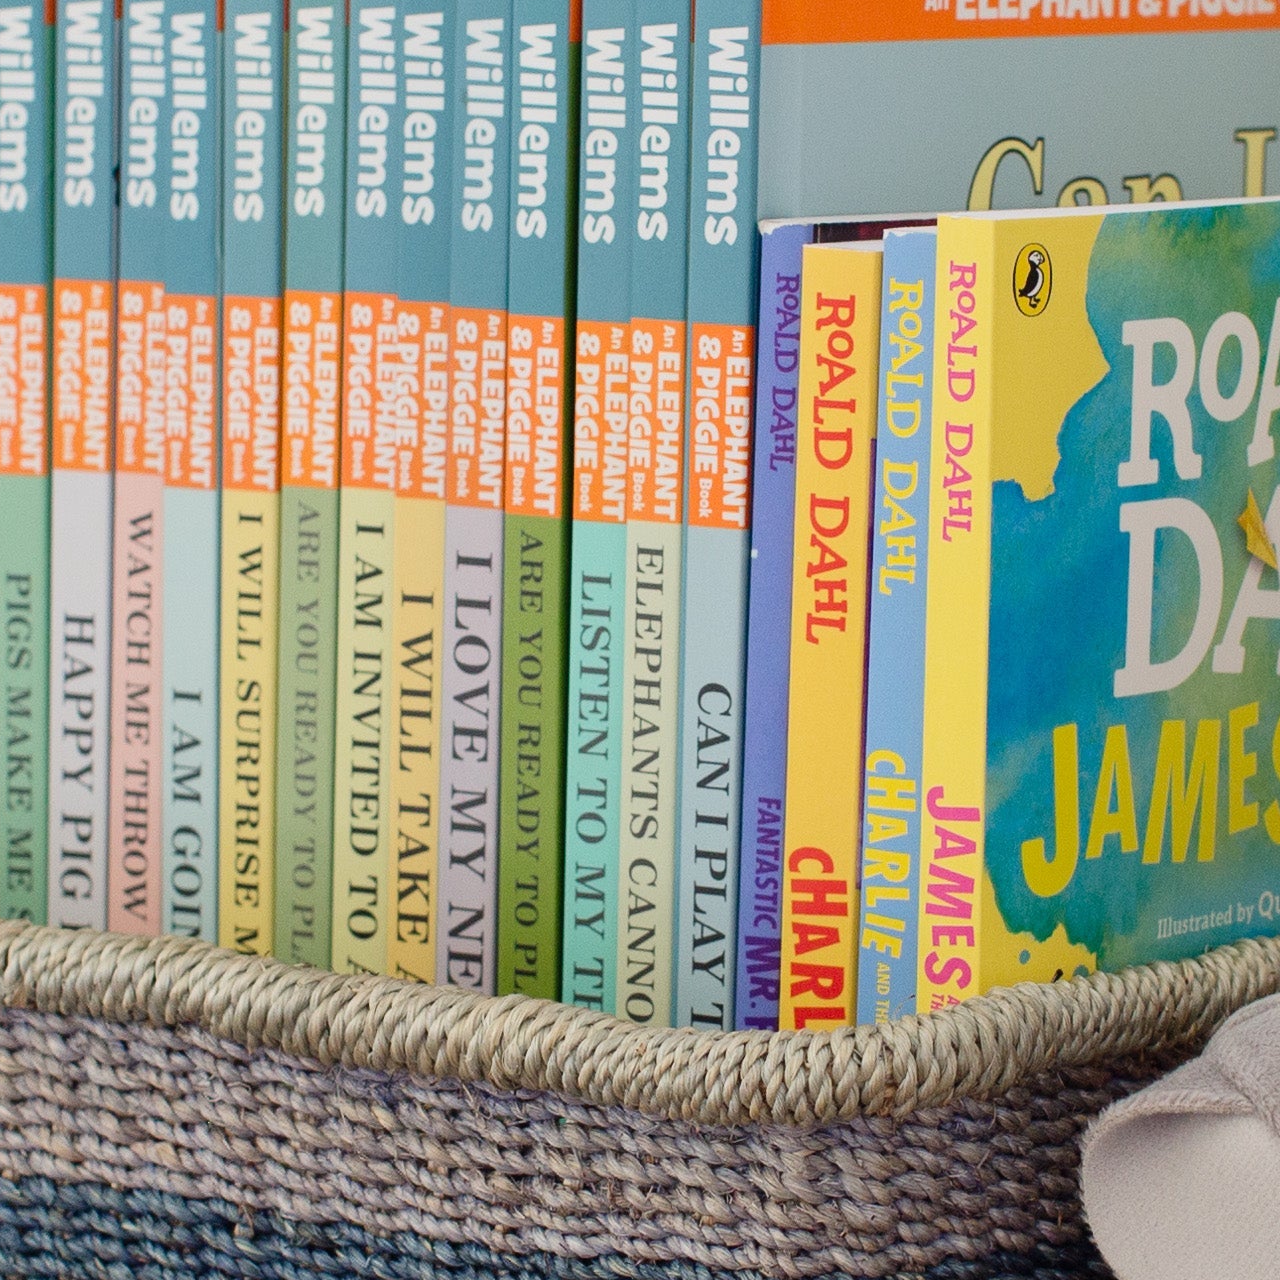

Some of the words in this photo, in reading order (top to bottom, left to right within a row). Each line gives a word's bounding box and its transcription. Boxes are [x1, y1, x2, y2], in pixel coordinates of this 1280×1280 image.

[64, 0, 103, 209] Willems
[127, 0, 165, 210] Willems
[169, 12, 207, 222] Willems
[233, 11, 273, 223] Willems
[294, 5, 334, 220] Willems
[355, 6, 397, 219] Willems
[401, 11, 444, 226] Willems
[461, 18, 504, 234] Willems
[516, 23, 557, 240] Willems
[582, 27, 625, 246] Willems
[638, 23, 678, 243] Willems
[703, 26, 749, 247] Willems
[350, 303, 373, 328] &
[397, 312, 420, 337] &
[456, 318, 478, 345] &
[511, 326, 533, 351] &
[542, 321, 555, 344] An
[578, 331, 601, 357] &
[611, 327, 624, 350] An
[632, 329, 653, 355] &
[663, 325, 676, 348] An
[698, 335, 721, 360] &
[732, 330, 746, 353] An
[773, 273, 801, 374] ROALD
[884, 277, 924, 439] ROALD
[947, 260, 978, 404] ROALD
[166, 335, 188, 439] PIGGIE
[190, 325, 213, 488] ELEPHANT
[228, 337, 251, 440] PIGGIE
[253, 327, 278, 490] ELEPHANT
[287, 332, 312, 437] PIGGIE
[312, 322, 337, 487] ELEPHANT
[348, 334, 373, 438] PIGGIE
[373, 323, 398, 489] ELEPHANT
[395, 342, 420, 447] PIGGIE
[422, 332, 448, 499] ELEPHANT
[453, 349, 478, 455] PIGGIE
[478, 340, 506, 507] ELEPHANT
[508, 357, 533, 463] PIGGIE
[534, 347, 559, 516] ELEPHANT
[574, 363, 600, 469] PIGGIE
[629, 361, 653, 468] PIGGIE
[694, 366, 721, 474] PIGGIE
[769, 386, 797, 472] DAHL
[813, 291, 857, 471] ROALD
[512, 467, 526, 506] Book
[602, 353, 628, 521] ELEPHANT
[654, 351, 680, 520] ELEPHANT
[722, 356, 751, 527] ELEPHANT
[942, 421, 974, 542] DAHL
[238, 512, 262, 524] I
[295, 501, 320, 584] ARE
[355, 521, 384, 538] I
[579, 473, 593, 512] Book
[632, 472, 645, 512] Book
[698, 478, 712, 518] Book
[879, 459, 919, 596] DAHL
[126, 511, 153, 666] WATCH
[236, 545, 262, 661] WILL
[354, 555, 384, 631] AM
[401, 591, 434, 610] I
[456, 549, 493, 572] I
[520, 529, 544, 613] ARE
[804, 493, 851, 646] DAHL
[5, 572, 31, 670] PIGS
[294, 597, 319, 676] YOU
[518, 628, 543, 707] YOU
[577, 572, 613, 760] LISTEN
[62, 614, 95, 793] HAPPY
[124, 682, 150, 746] ME
[173, 689, 202, 703] I
[399, 629, 434, 772] WILL
[452, 592, 493, 763] LOVE
[629, 544, 665, 840] ELEPHANTS
[5, 685, 32, 813] MAKE
[171, 724, 202, 805] AM
[292, 690, 318, 822] READY
[349, 648, 383, 858] INVITED
[516, 723, 541, 862] READY
[696, 682, 732, 798] CAN
[122, 758, 148, 921] THROW
[234, 679, 261, 911] SURPRISE
[449, 785, 488, 883] MY
[575, 778, 607, 844] TO
[695, 811, 729, 829] I
[5, 827, 33, 893] ME
[60, 813, 95, 901] PIG
[291, 837, 316, 889] TO
[396, 794, 431, 944] TAKE
[513, 874, 538, 927] TO
[573, 863, 606, 940] MY
[753, 796, 782, 929] FANTASTIC
[862, 749, 917, 958] CHARLIE
[925, 785, 980, 989] JAMES
[347, 880, 378, 940] TO
[691, 845, 729, 989] PLAY
[1157, 904, 1232, 939] Illustrated
[1237, 902, 1253, 923] by
[743, 935, 781, 1009] MR.
[876, 961, 890, 995] AND
